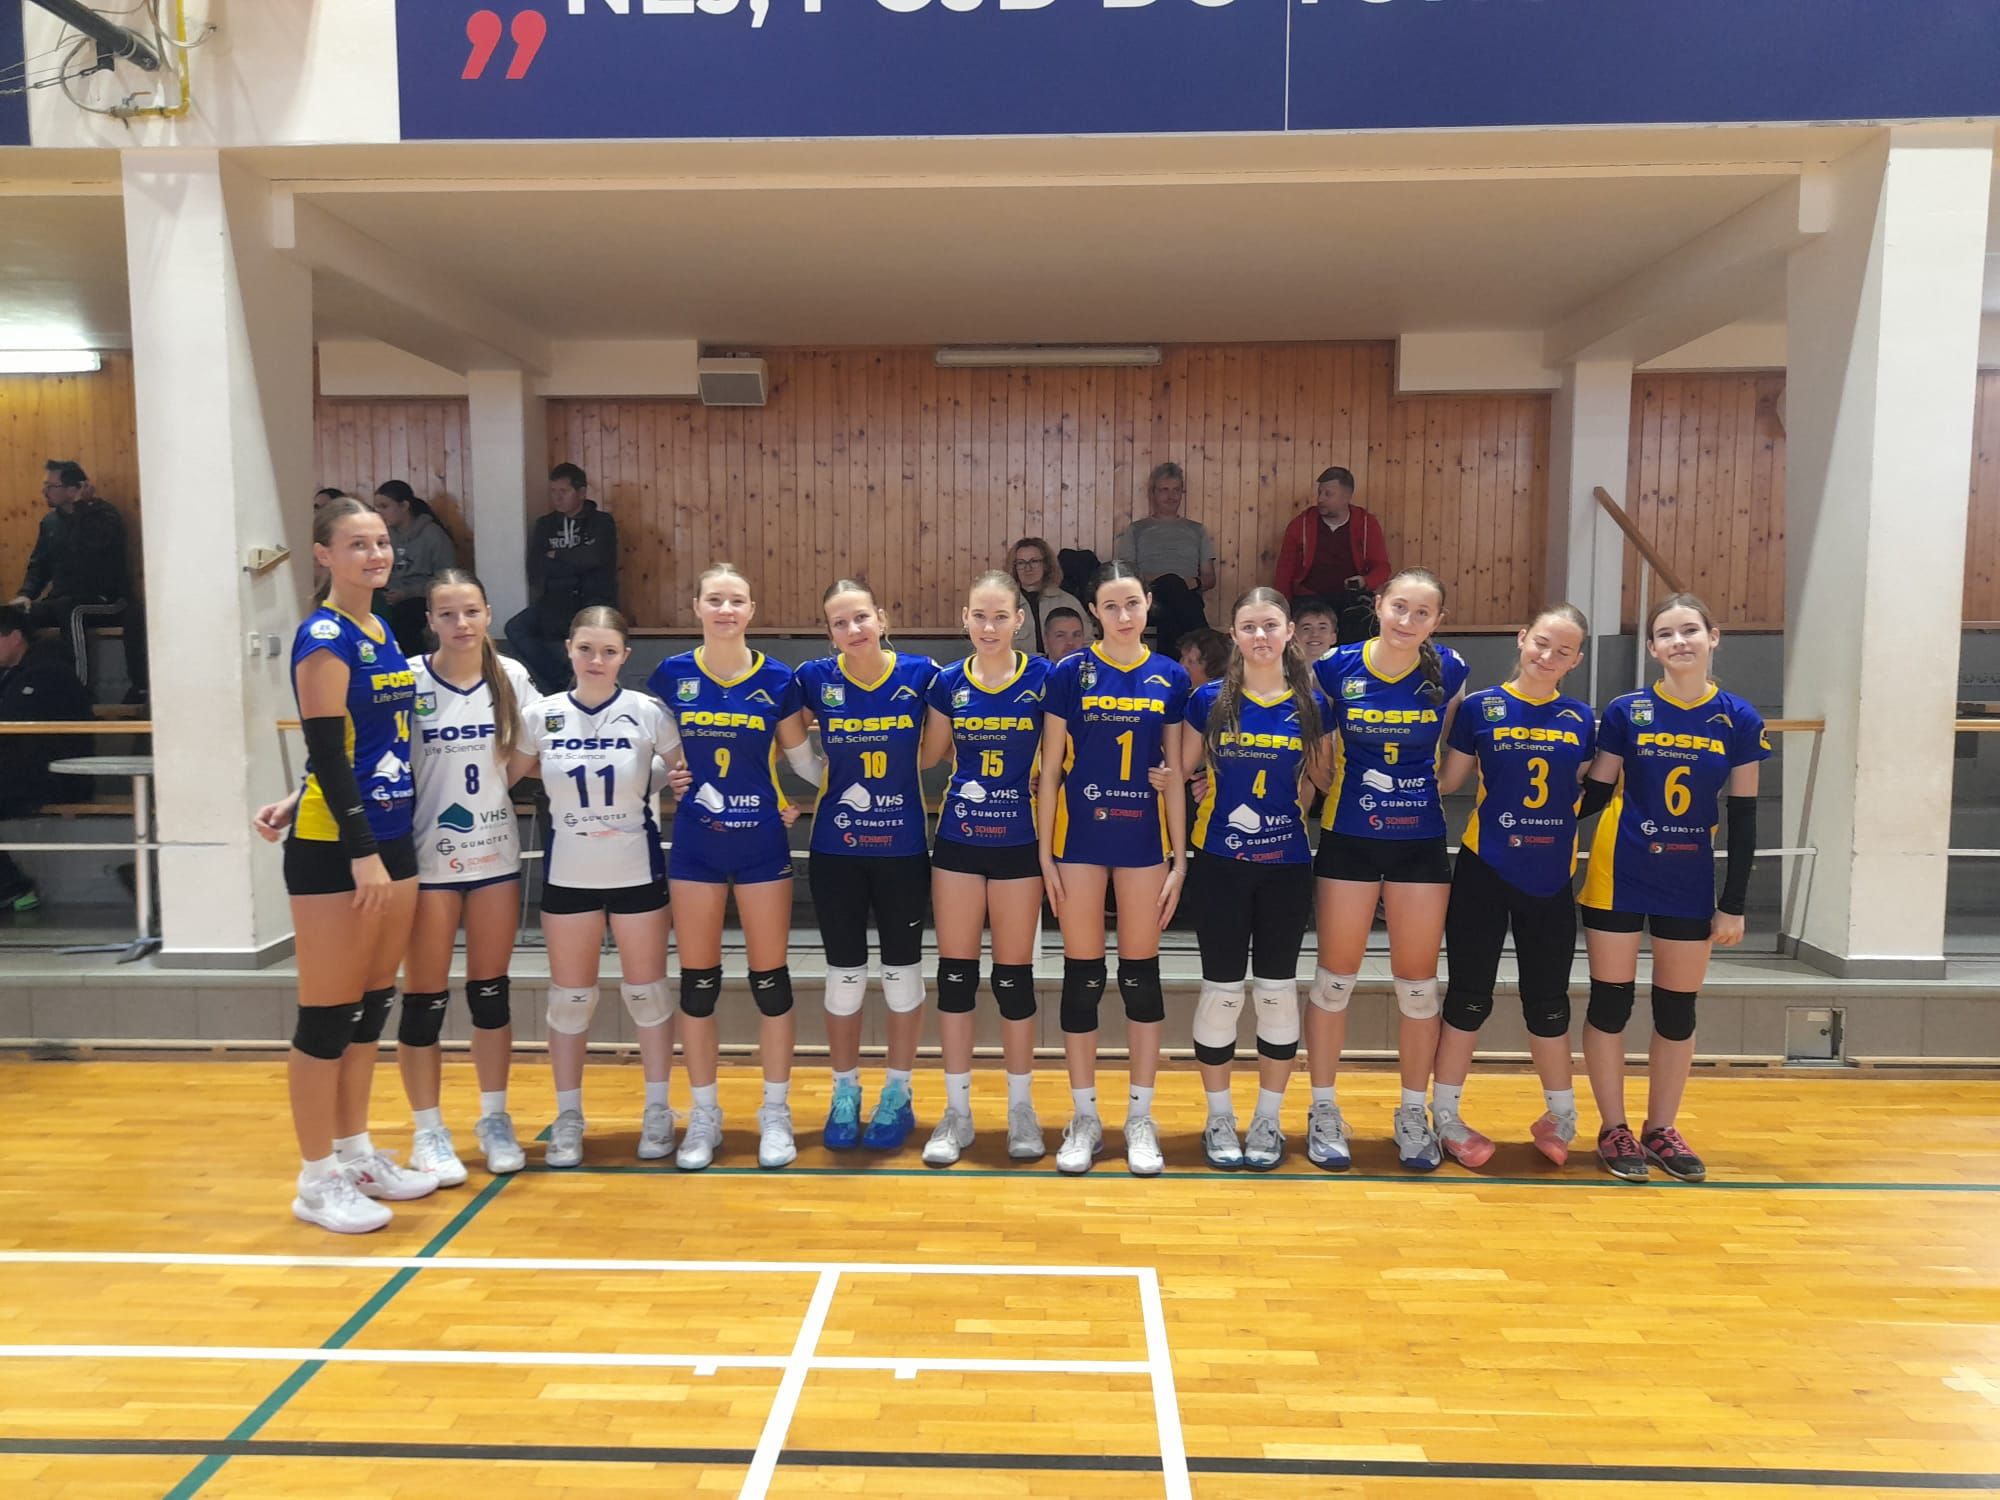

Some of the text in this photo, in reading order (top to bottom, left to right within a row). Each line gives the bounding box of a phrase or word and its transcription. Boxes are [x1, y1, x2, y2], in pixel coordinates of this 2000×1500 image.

[370, 670, 415, 691] FOSF
[1081, 696, 1166, 715] FOSFA
[680, 711, 766, 732] FOSFA
[1083, 713, 1141, 723] Life Science
[1346, 708, 1439, 724] FOSFA
[828, 715, 914, 733] FOSFA
[953, 717, 1034, 731] FOSFA
[1345, 722, 1411, 734] Life Science
[422, 724, 496, 744] FOSF
[827, 734, 889, 744] Life Science
[967, 733, 1008, 741] Science
[1219, 732, 1304, 751] FOSFA
[1493, 726, 1580, 746] FOSFA
[425, 744, 486, 756] Life Science
[551, 737, 632, 750] FOSFA
[1493, 742, 1555, 752] Life Science
[1636, 732, 1726, 756] FOSFA
[1115, 730, 1133, 781] 1
[1219, 749, 1279, 759] Life Science
[1383, 742, 1400, 765] 5
[1637, 749, 1699, 761] Life Science
[714, 747, 731, 778] 9
[859, 751, 888, 779] 10
[979, 749, 1004, 778] 15
[464, 763, 480, 795] 8
[566, 764, 615, 808] 11
[1252, 769, 1267, 799] 4
[1397, 777, 1426, 789] VHS
[1523, 757, 1550, 809] 3
[991, 789, 1020, 799] VHS
[1105, 790, 1151, 799] GUMOTE
[1664, 766, 1691, 816] 6
[728, 795, 761, 807] VHS
[875, 794, 904, 807] VHS
[480, 808, 508, 823] VHS
[970, 810, 1018, 818] GUMOTEX
[854, 819, 904, 827] GUMOTEX
[1520, 818, 1564, 826] GUMOTEX
[461, 834, 508, 849] GUMOTEX
[1246, 833, 1293, 846] GUMOTEX
